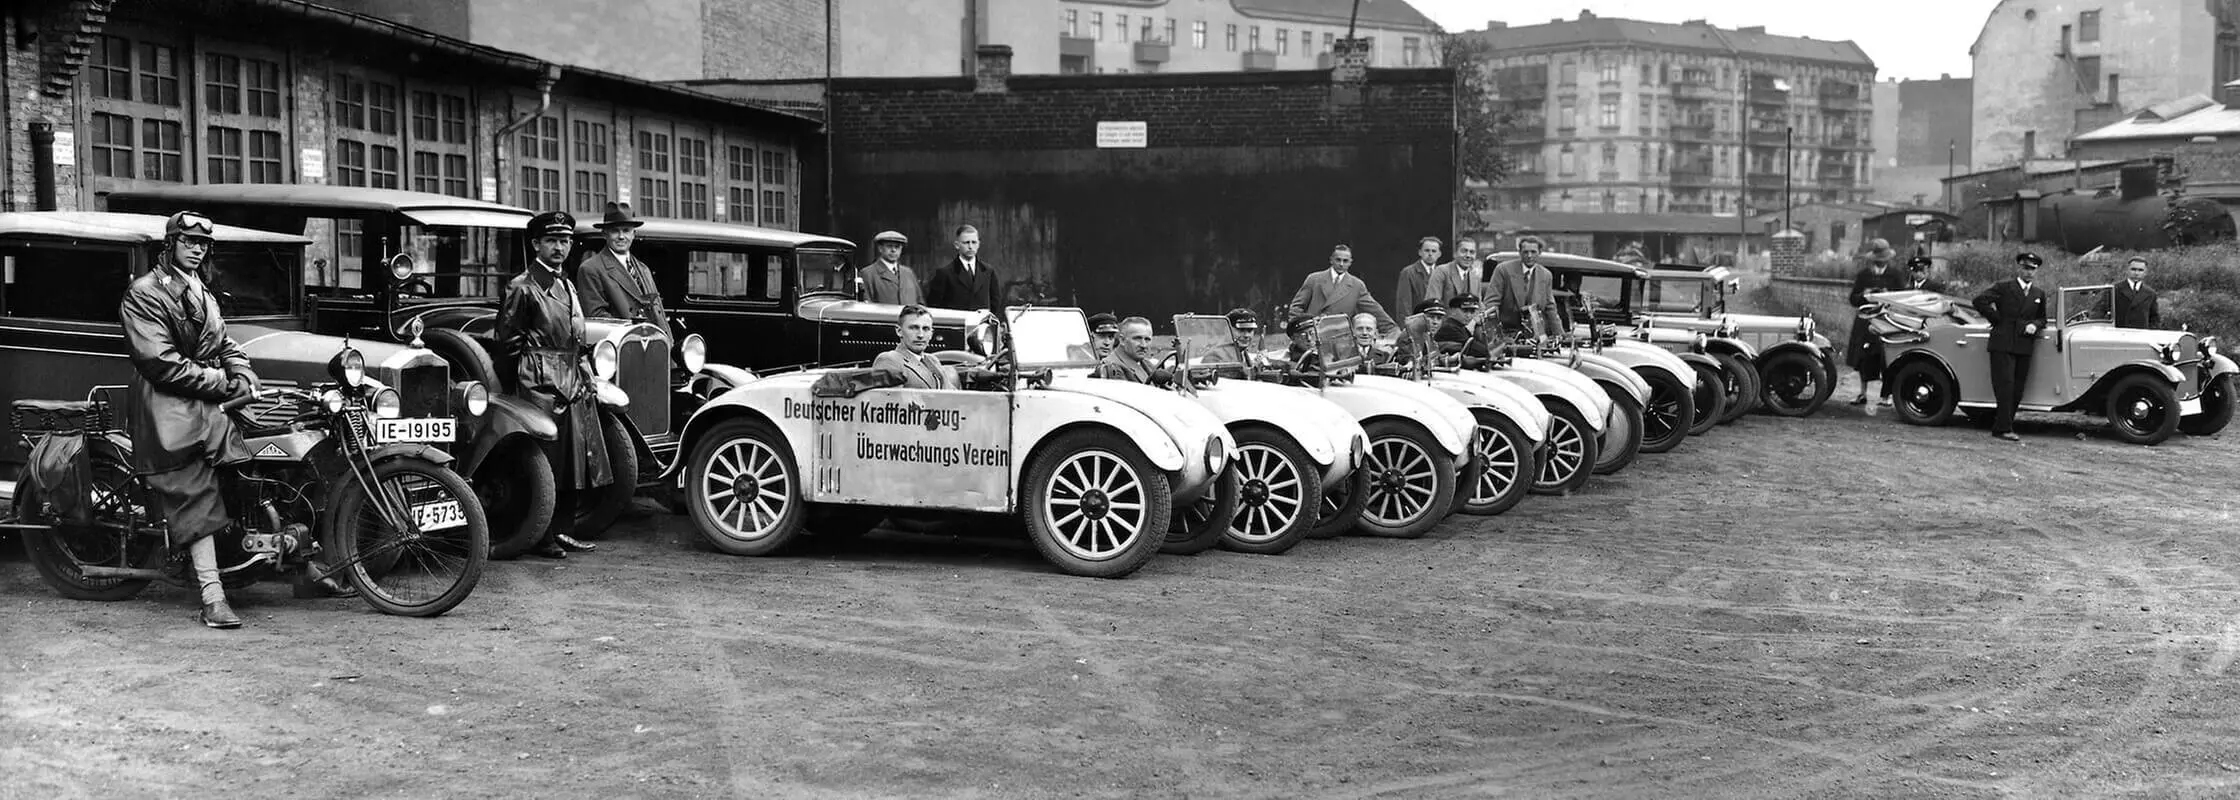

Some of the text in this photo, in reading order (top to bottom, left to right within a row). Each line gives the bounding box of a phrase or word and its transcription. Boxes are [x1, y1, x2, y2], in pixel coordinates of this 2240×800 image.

[784, 397, 856, 423] Deutscher
[382, 422, 451, 439] IE-19195
[857, 432, 1009, 467] Überwachungs Verein
